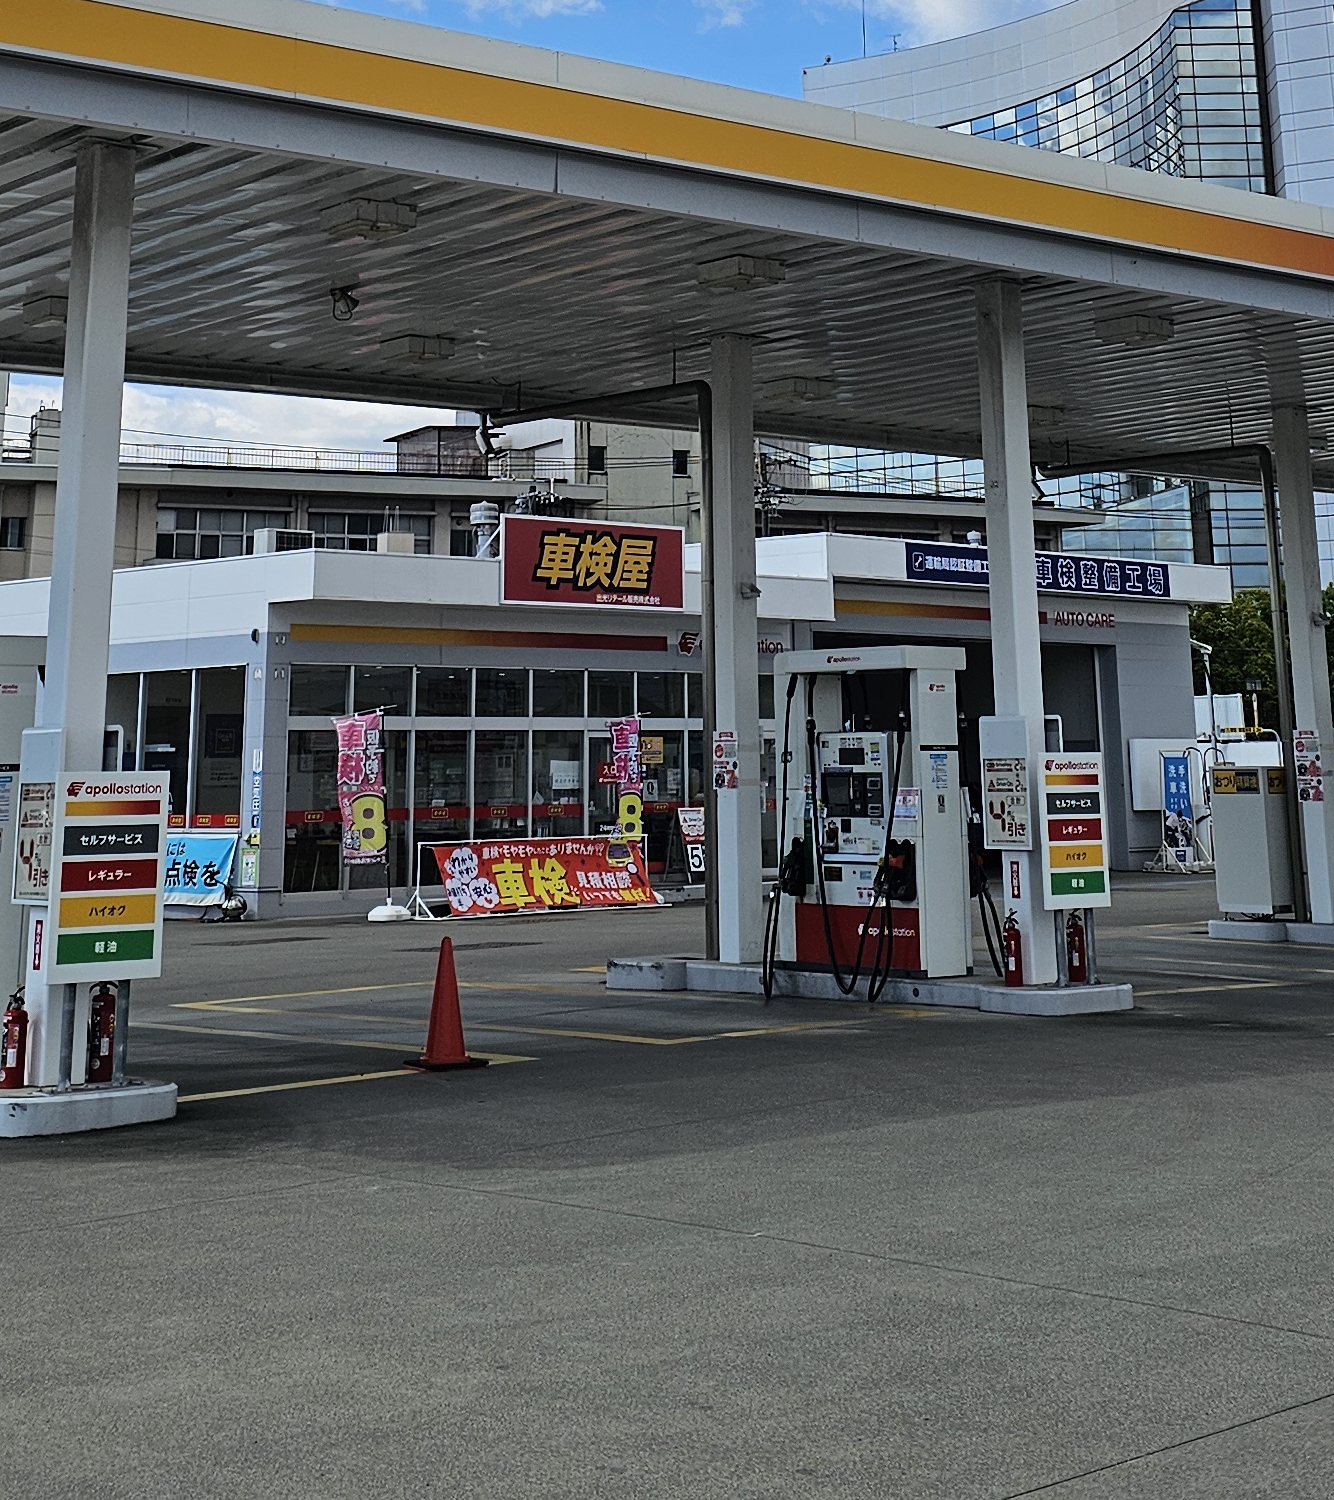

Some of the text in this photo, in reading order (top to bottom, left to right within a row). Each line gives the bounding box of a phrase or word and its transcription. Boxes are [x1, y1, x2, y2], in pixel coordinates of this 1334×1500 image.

[534, 531, 656, 590] 車検屋
[925, 555, 990, 574] 運輸局認証整備工
[1035, 556, 1165, 595] 車検整備工場
[1054, 611, 1115, 629] AUTO CARE
[1054, 760, 1099, 772] apollostation
[85, 782, 162, 798] apollostation
[1055, 799, 1092, 808] セルフサービス
[989, 800, 1006, 833] 4
[1007, 821, 1027, 838] 引き
[1062, 826, 1088, 835] レギュラー
[79, 833, 143, 846] セルフサービス
[1065, 852, 1087, 861] ハイオク
[32, 867, 49, 888] 引き
[88, 869, 132, 882] レギュラー
[164, 858, 221, 888] 点検を
[575, 871, 633, 889] 見積相談
[492, 857, 581, 907] 車検
[472, 883, 493, 899] 安心
[88, 904, 127, 918] ハイオク
[94, 940, 118, 954] 軽油
